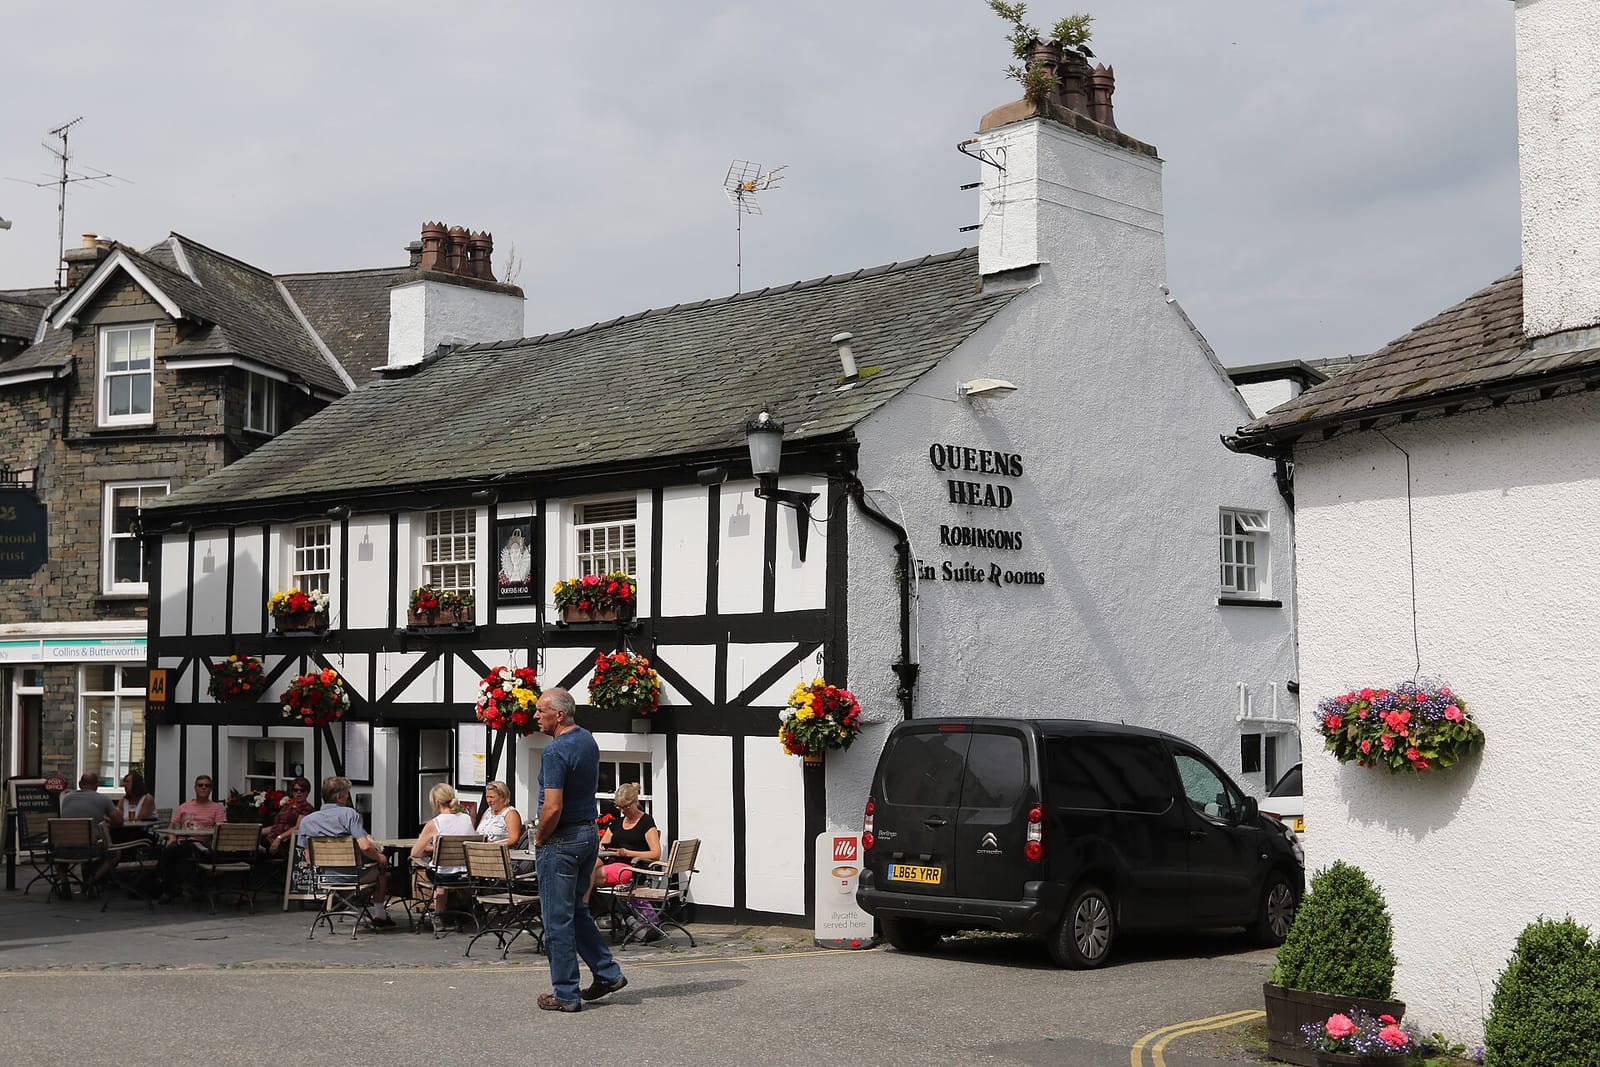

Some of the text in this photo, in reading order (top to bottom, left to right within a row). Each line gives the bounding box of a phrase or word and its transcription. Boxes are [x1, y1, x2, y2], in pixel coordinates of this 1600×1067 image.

[929, 443, 1024, 478] QUEENS
[947, 479, 1013, 509] HEAD
[939, 524, 1023, 551] ROBINSONS
[942, 560, 985, 582] Suite
[987, 561, 1045, 588] Rooms
[53, 647, 80, 658] Collins
[81, 647, 88, 657] &
[89, 644, 139, 657] Butterworth
[151, 677, 164, 694] AA
[835, 840, 856, 859] illy
[893, 865, 940, 881] LB65 YRR
[823, 920, 866, 929] served here
